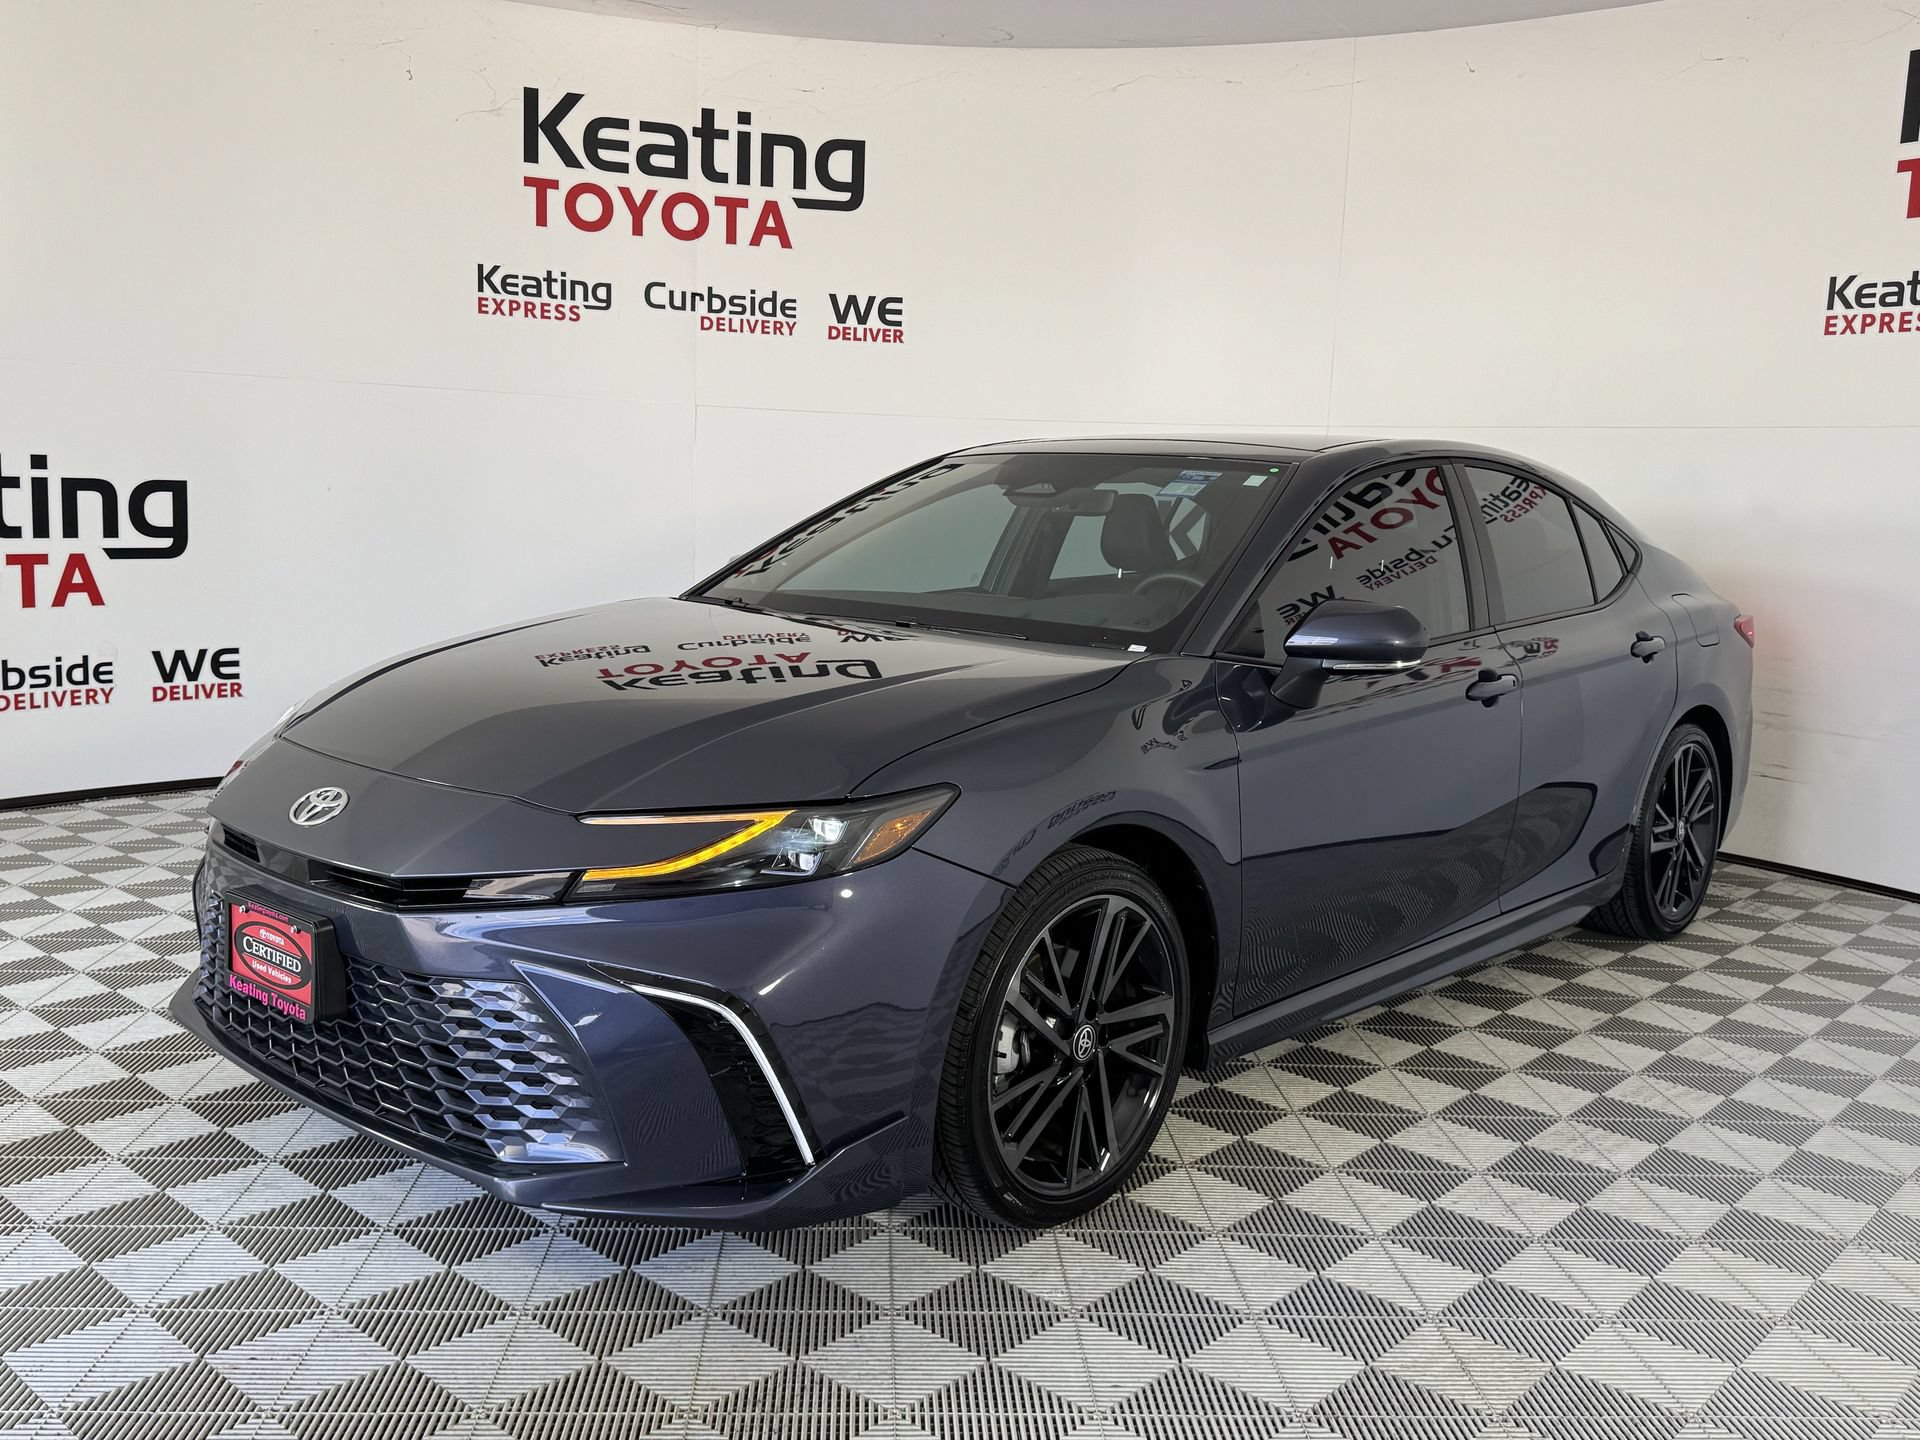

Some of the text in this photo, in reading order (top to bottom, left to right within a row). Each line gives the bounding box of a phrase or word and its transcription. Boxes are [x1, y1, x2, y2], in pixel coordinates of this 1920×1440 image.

[523, 86, 866, 211] Keating
[523, 175, 793, 249] TOYOTA
[477, 263, 612, 310] Keating
[644, 281, 797, 319] Curbside
[477, 296, 581, 322] EXPRESS
[700, 316, 797, 336] DELIVERY
[827, 325, 904, 344] DELIVER
[152, 682, 243, 702] DELIVER
[243, 935, 302, 973] CERTIFIED
[251, 960, 292, 984] Used Vehicles
[229, 974, 307, 1021] Keating Toyota
